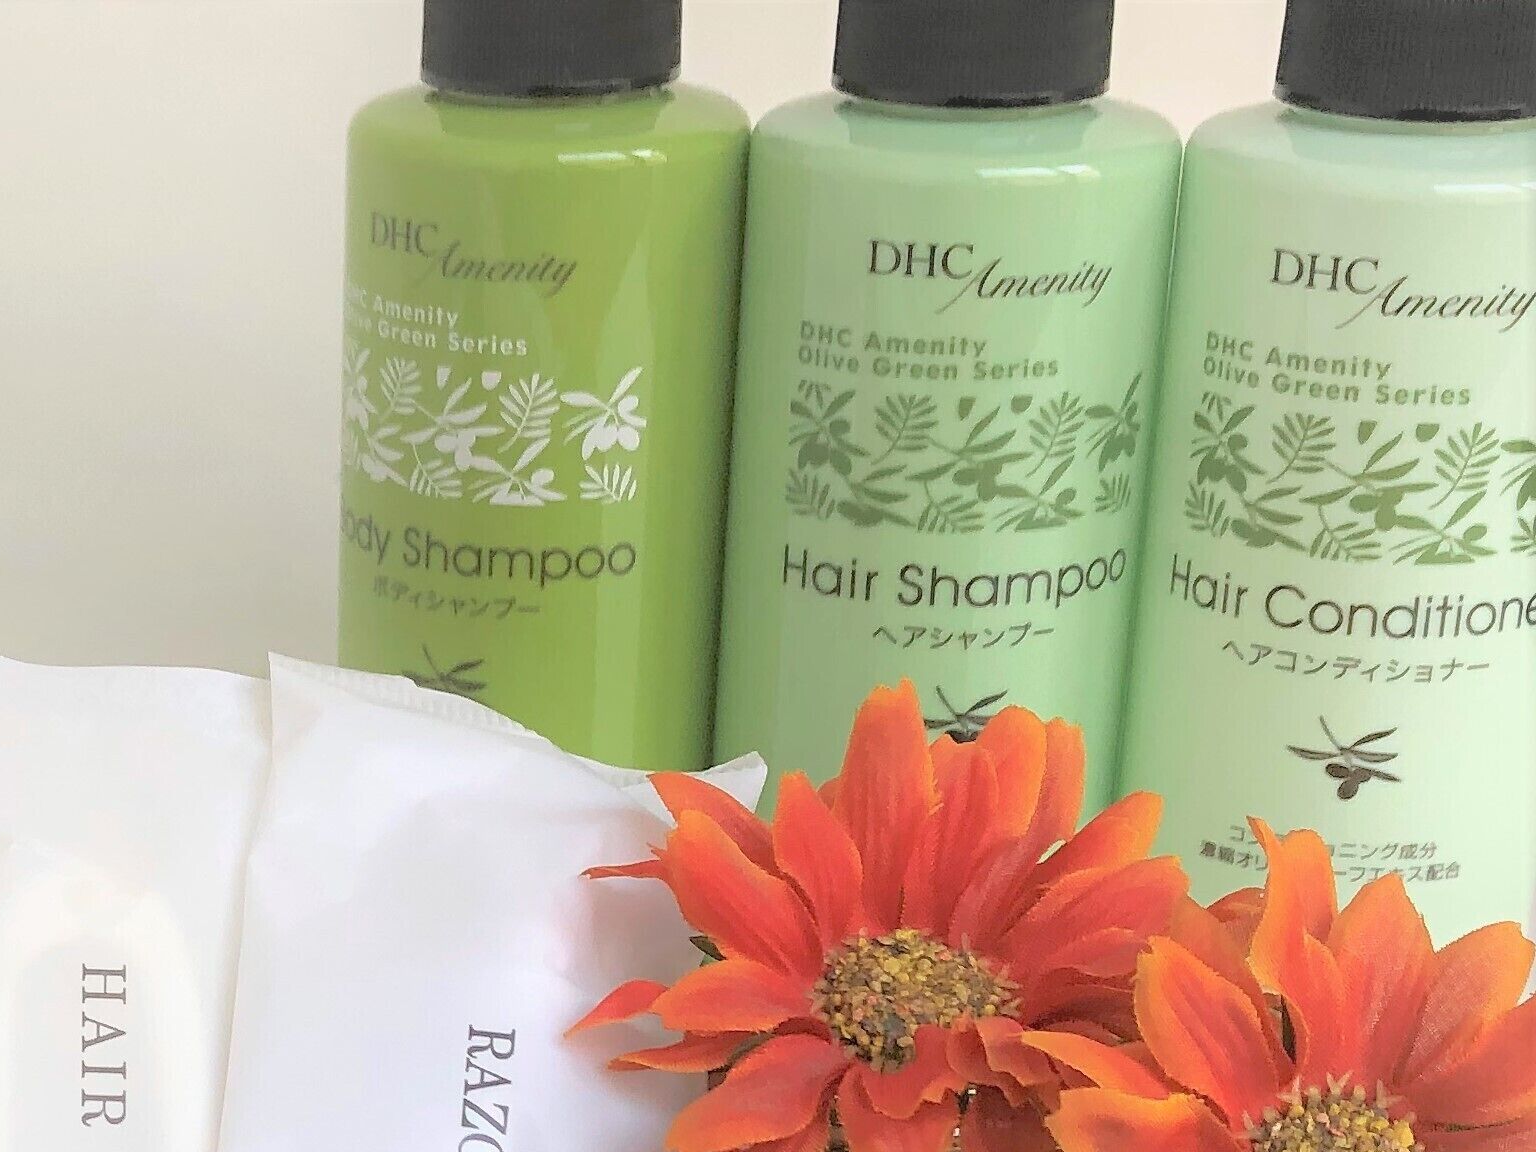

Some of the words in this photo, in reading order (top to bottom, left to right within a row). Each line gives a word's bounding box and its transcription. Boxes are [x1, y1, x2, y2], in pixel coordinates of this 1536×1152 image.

[370, 210, 440, 258] DHC
[415, 240, 578, 299] Amenity
[868, 239, 974, 279] DHC
[934, 257, 1112, 314] Amenity
[372, 295, 459, 329] Amenity
[1271, 248, 1380, 295] DHC
[1334, 275, 1536, 333] Amenity
[378, 320, 436, 349] Green
[448, 332, 528, 356] Series
[799, 347, 859, 374] Olive
[872, 356, 958, 381] Green
[973, 358, 1059, 381] Series
[800, 320, 852, 348] DHC
[864, 331, 987, 357] Amenity
[1206, 331, 1254, 362] DHC
[1265, 346, 1392, 380] Amenity
[1203, 356, 1260, 389] Olive
[1271, 373, 1360, 402] Green
[1376, 383, 1471, 406] Series
[340, 508, 391, 566] ody
[403, 526, 636, 589] Shampoo
[782, 543, 879, 602] Hair
[897, 548, 1127, 608] Shampoo
[1170, 554, 1248, 618] Hair
[1222, 640, 1490, 684] ヘアコンディショナー
[80, 963, 128, 1128] HAIR
